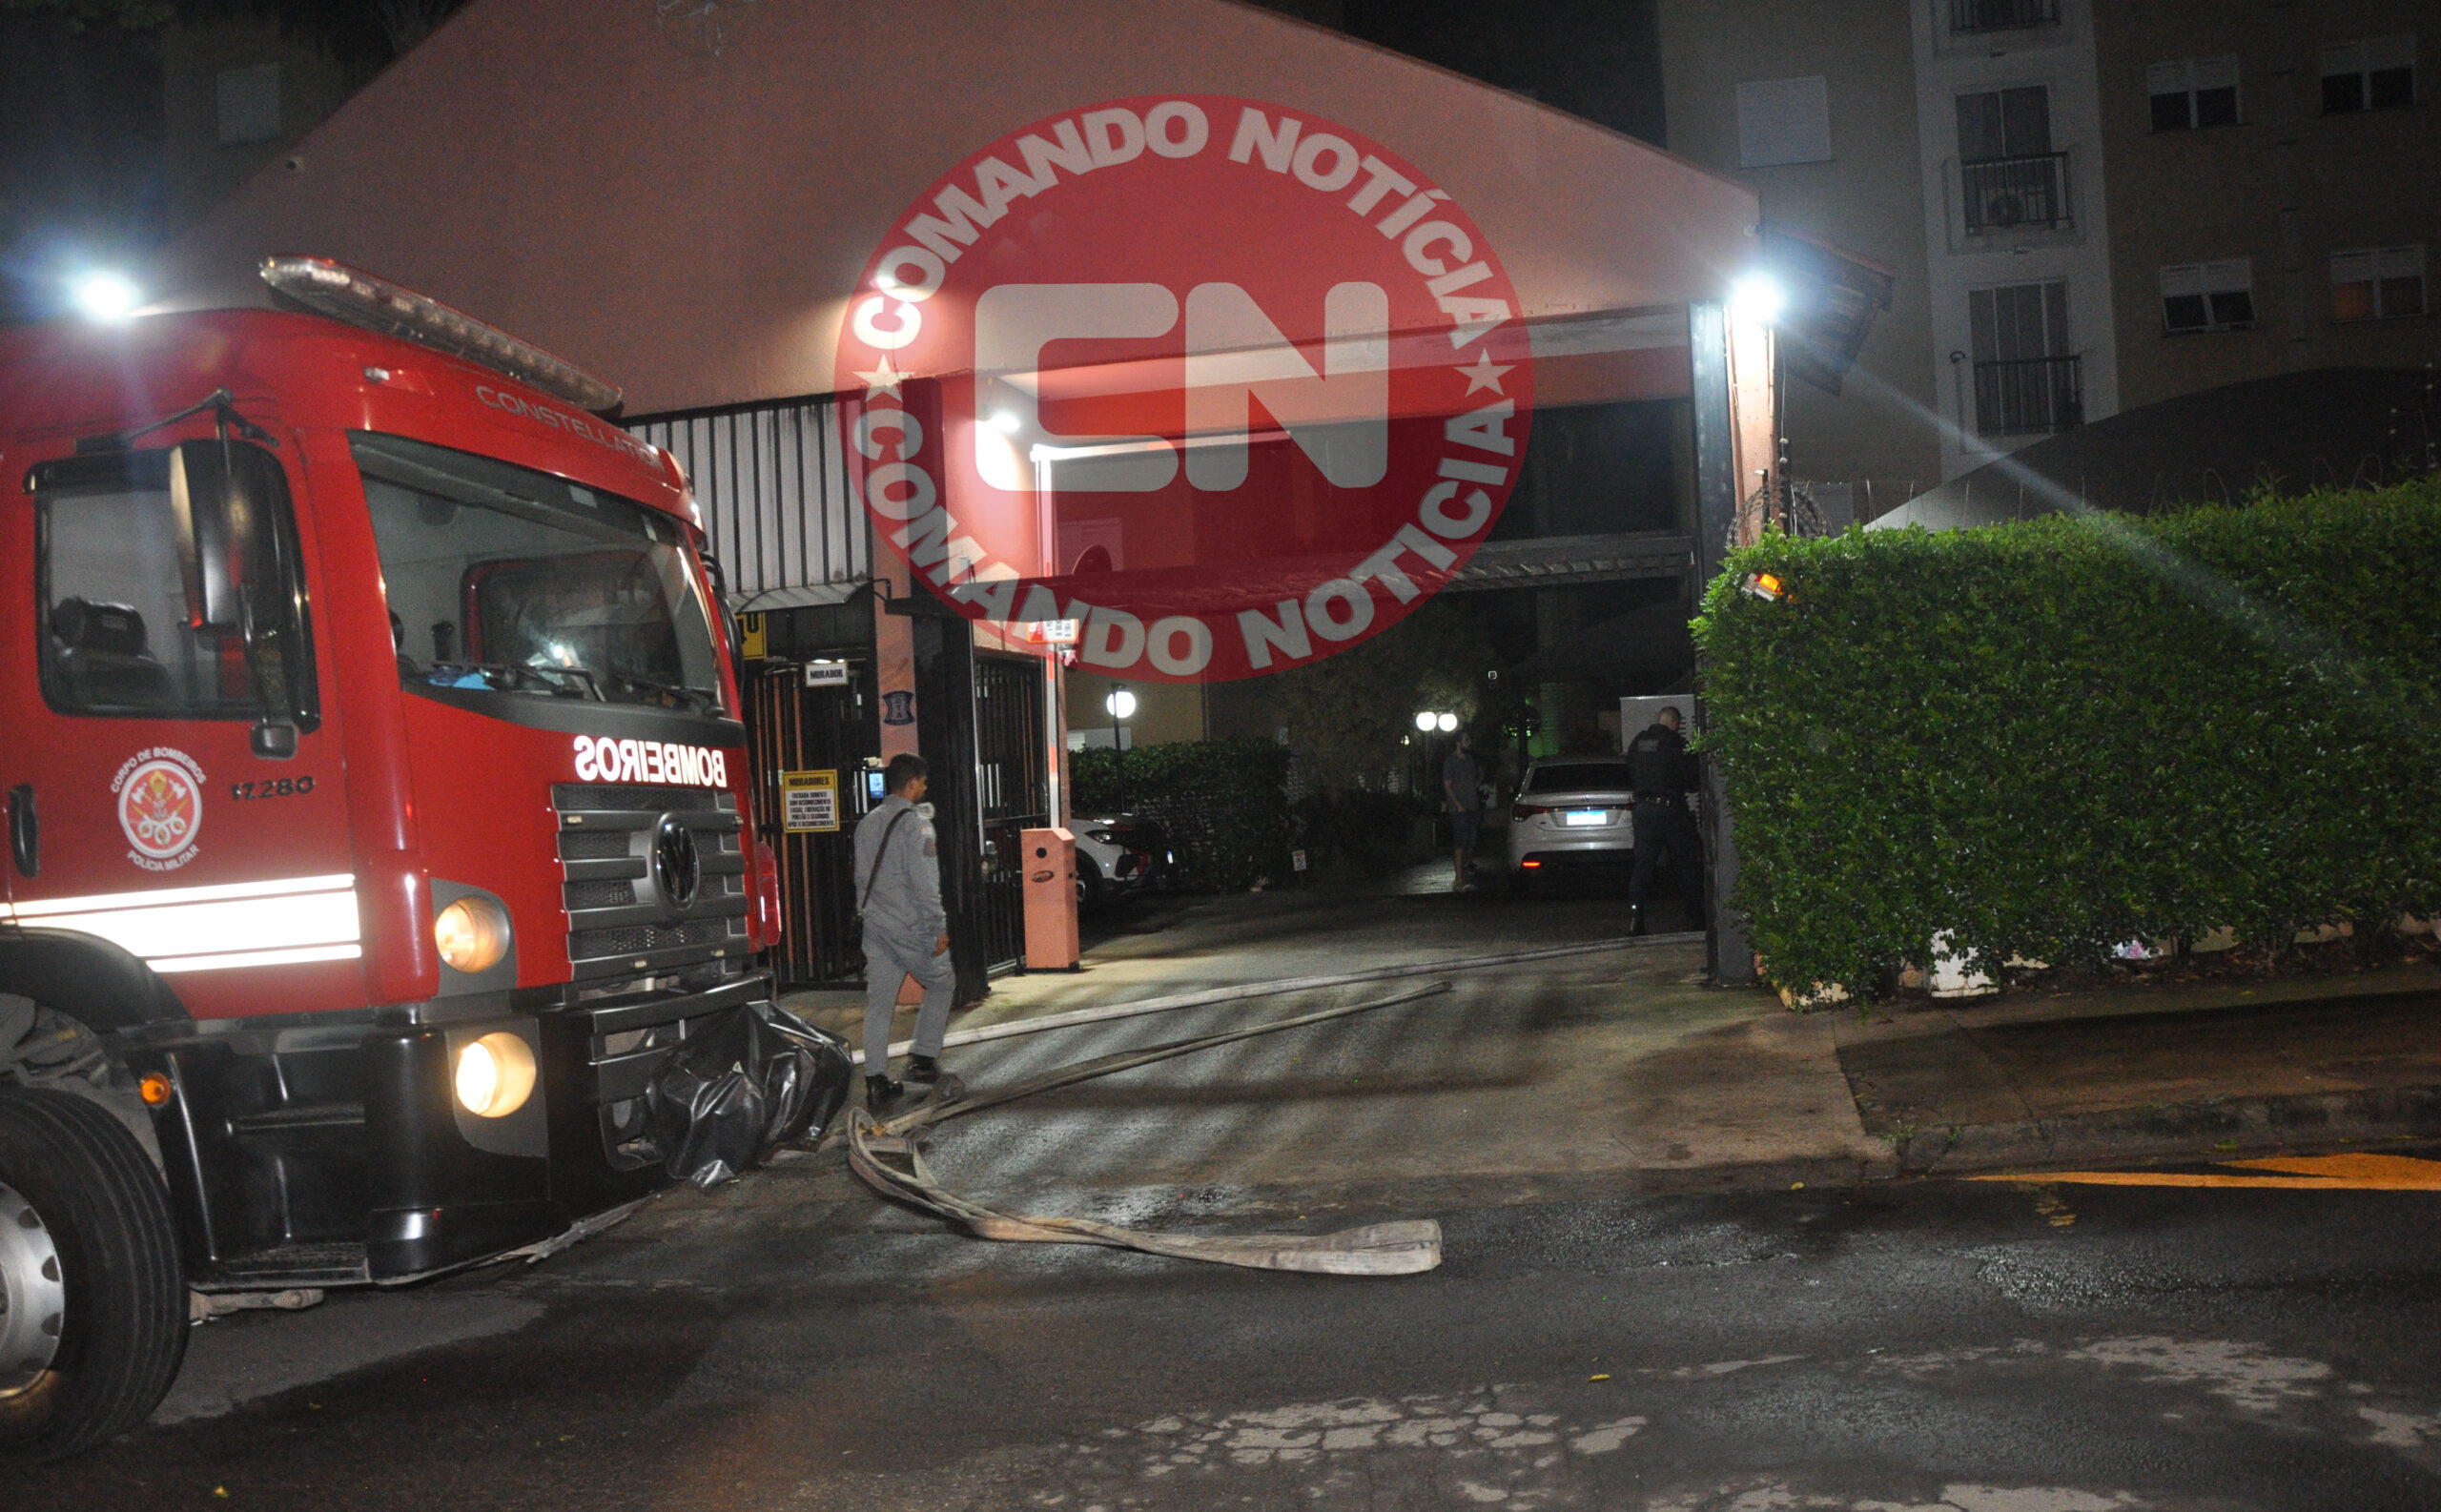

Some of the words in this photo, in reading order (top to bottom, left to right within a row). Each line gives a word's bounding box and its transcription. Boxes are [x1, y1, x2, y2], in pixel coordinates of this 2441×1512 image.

[476, 385, 666, 473] CONSTELLATION
[810, 669, 844, 680] MORADOR
[111, 757, 138, 793] CORPO
[137, 748, 152, 762] DE
[153, 746, 207, 784] BOMBEIROS
[164, 844, 200, 870] MILITAR
